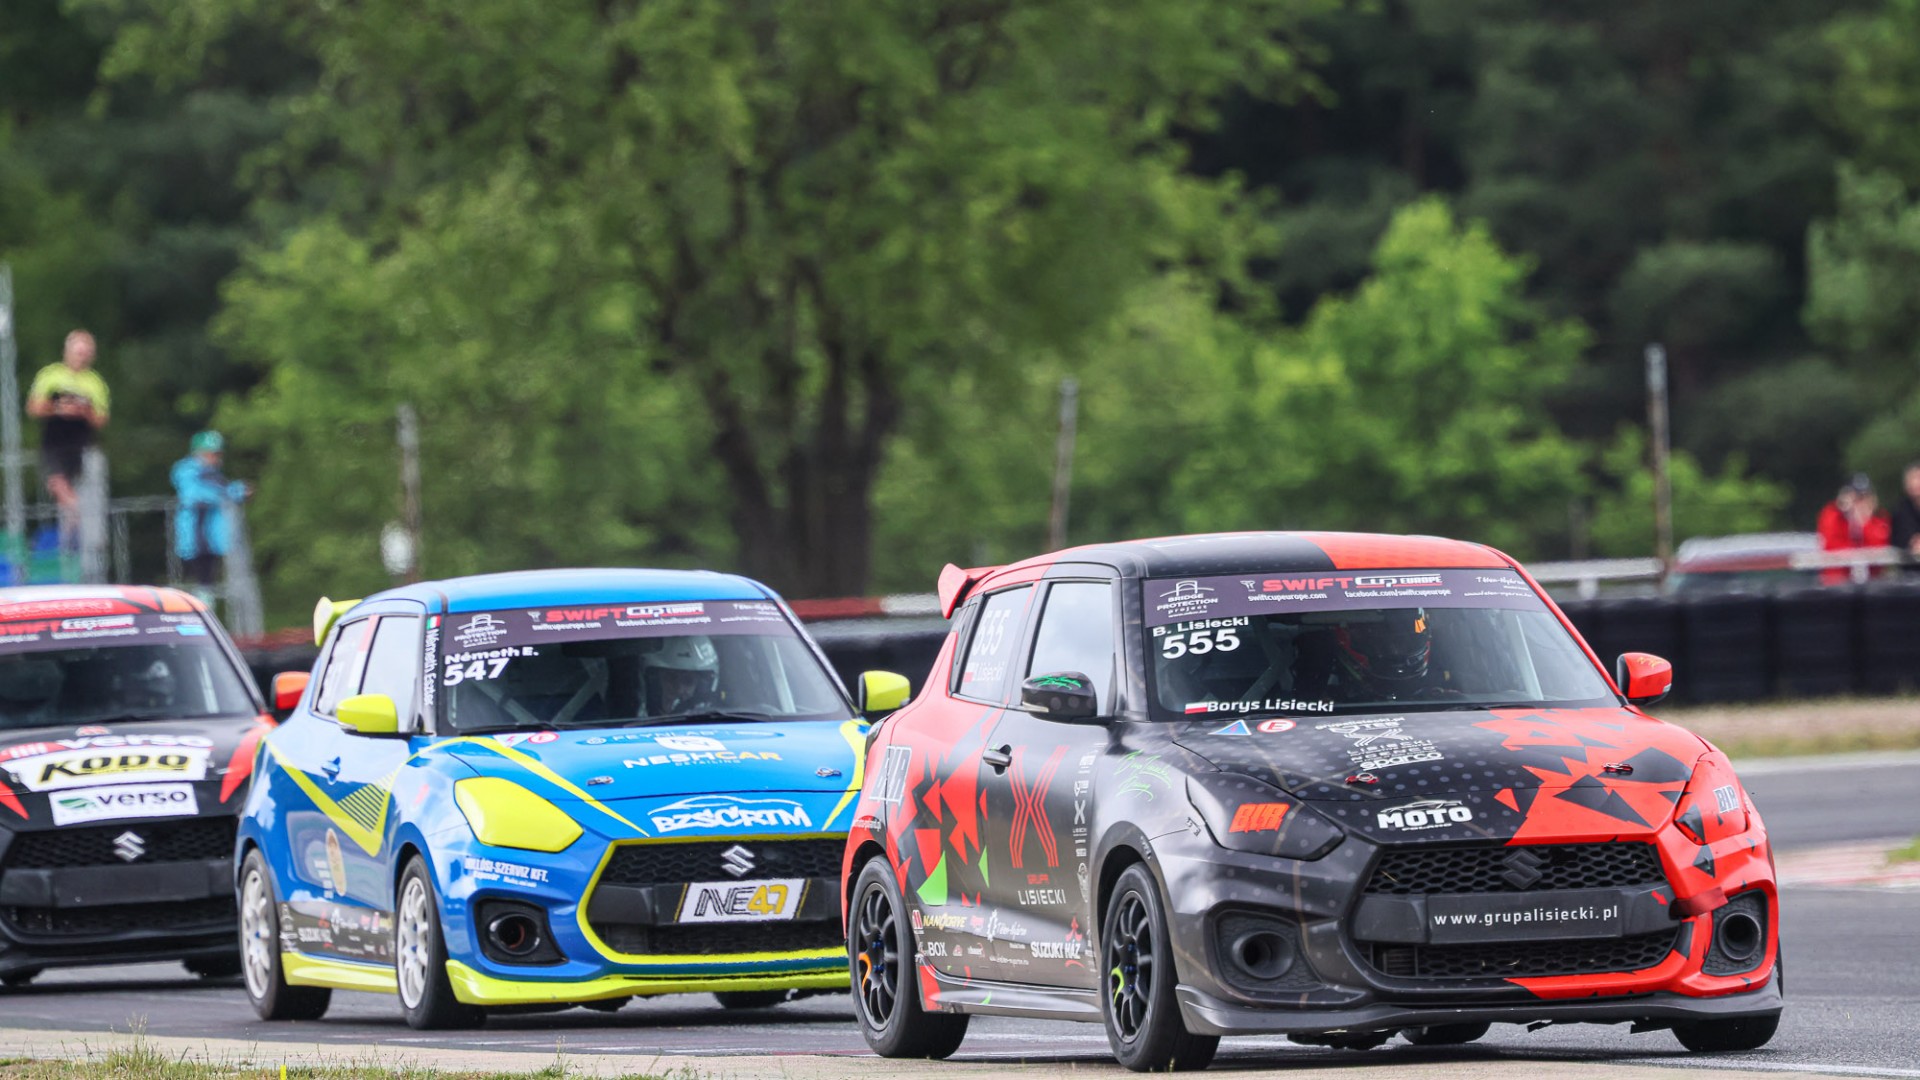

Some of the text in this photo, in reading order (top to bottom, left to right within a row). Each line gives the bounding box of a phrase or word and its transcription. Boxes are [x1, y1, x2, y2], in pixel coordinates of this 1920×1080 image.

[1262, 575, 1442, 592] SWIFT CUP EUROPE
[1156, 598, 1219, 612] PROTECTION
[1167, 593, 1204, 603] BRIDGE
[1248, 592, 1328, 602] swiftcupeurope.com
[546, 608, 627, 622] SWIFT
[973, 610, 1011, 656] 555
[1153, 616, 1249, 638] B. Lisiecki
[1162, 628, 1241, 660] 555
[444, 646, 540, 665] Németh E.
[443, 657, 510, 687] 547
[1207, 699, 1334, 713] Borys Lisiecki
[623, 751, 783, 769] NESHCAR
[1360, 752, 1442, 769] sparco
[39, 754, 190, 784] KODO
[97, 790, 188, 805] verso
[1377, 806, 1473, 829] MOTO
[1017, 889, 1067, 905] LISIECKI
[1434, 905, 1618, 926] www.grupalisiecki.pl
[1030, 942, 1065, 959] SUZUKI
